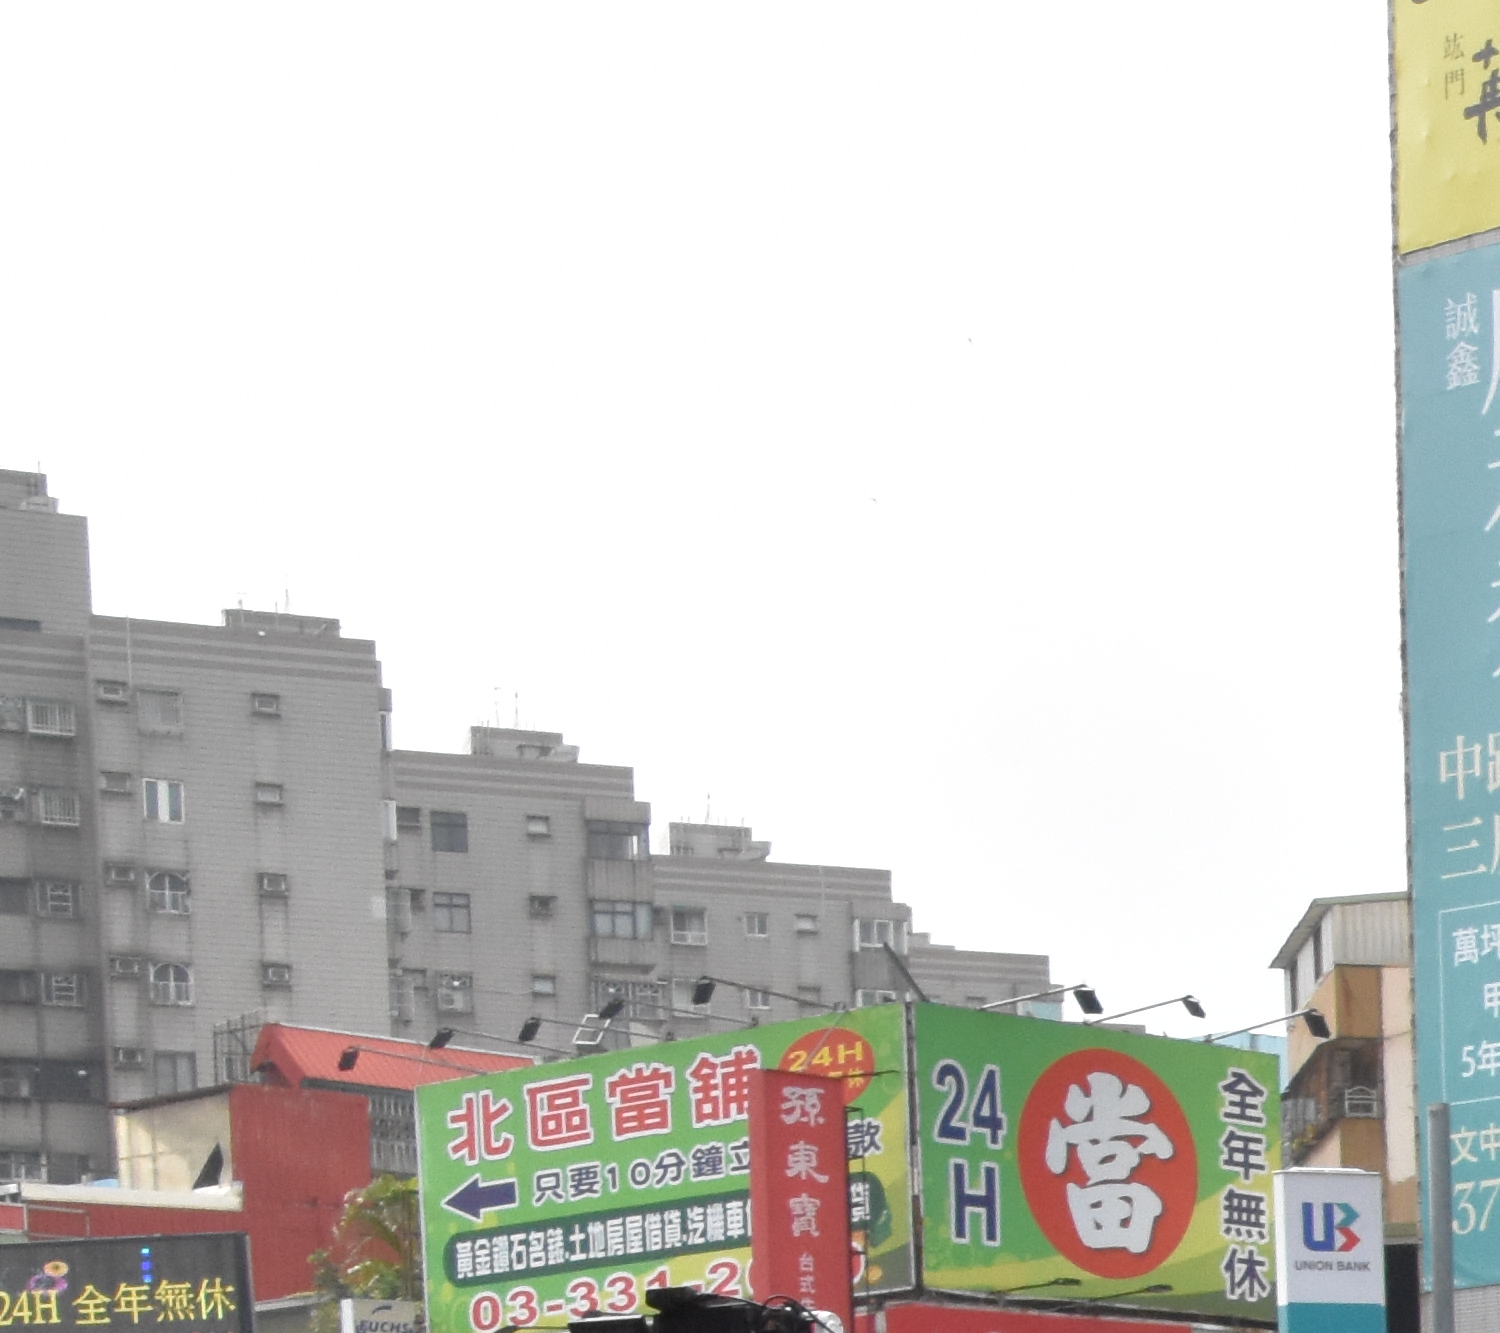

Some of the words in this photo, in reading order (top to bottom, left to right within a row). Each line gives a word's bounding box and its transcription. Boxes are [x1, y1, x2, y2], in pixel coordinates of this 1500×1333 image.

[932, 1058, 1006, 1150] 24
[949, 1158, 1000, 1247] H
[1045, 1071, 1174, 1254] 當
[1219, 1067, 1271, 1302] 全年無休
[72, 1277, 237, 1325] 全年無休
[1294, 1260, 1333, 1272] UNION
[1337, 1260, 1371, 1272] BANK
